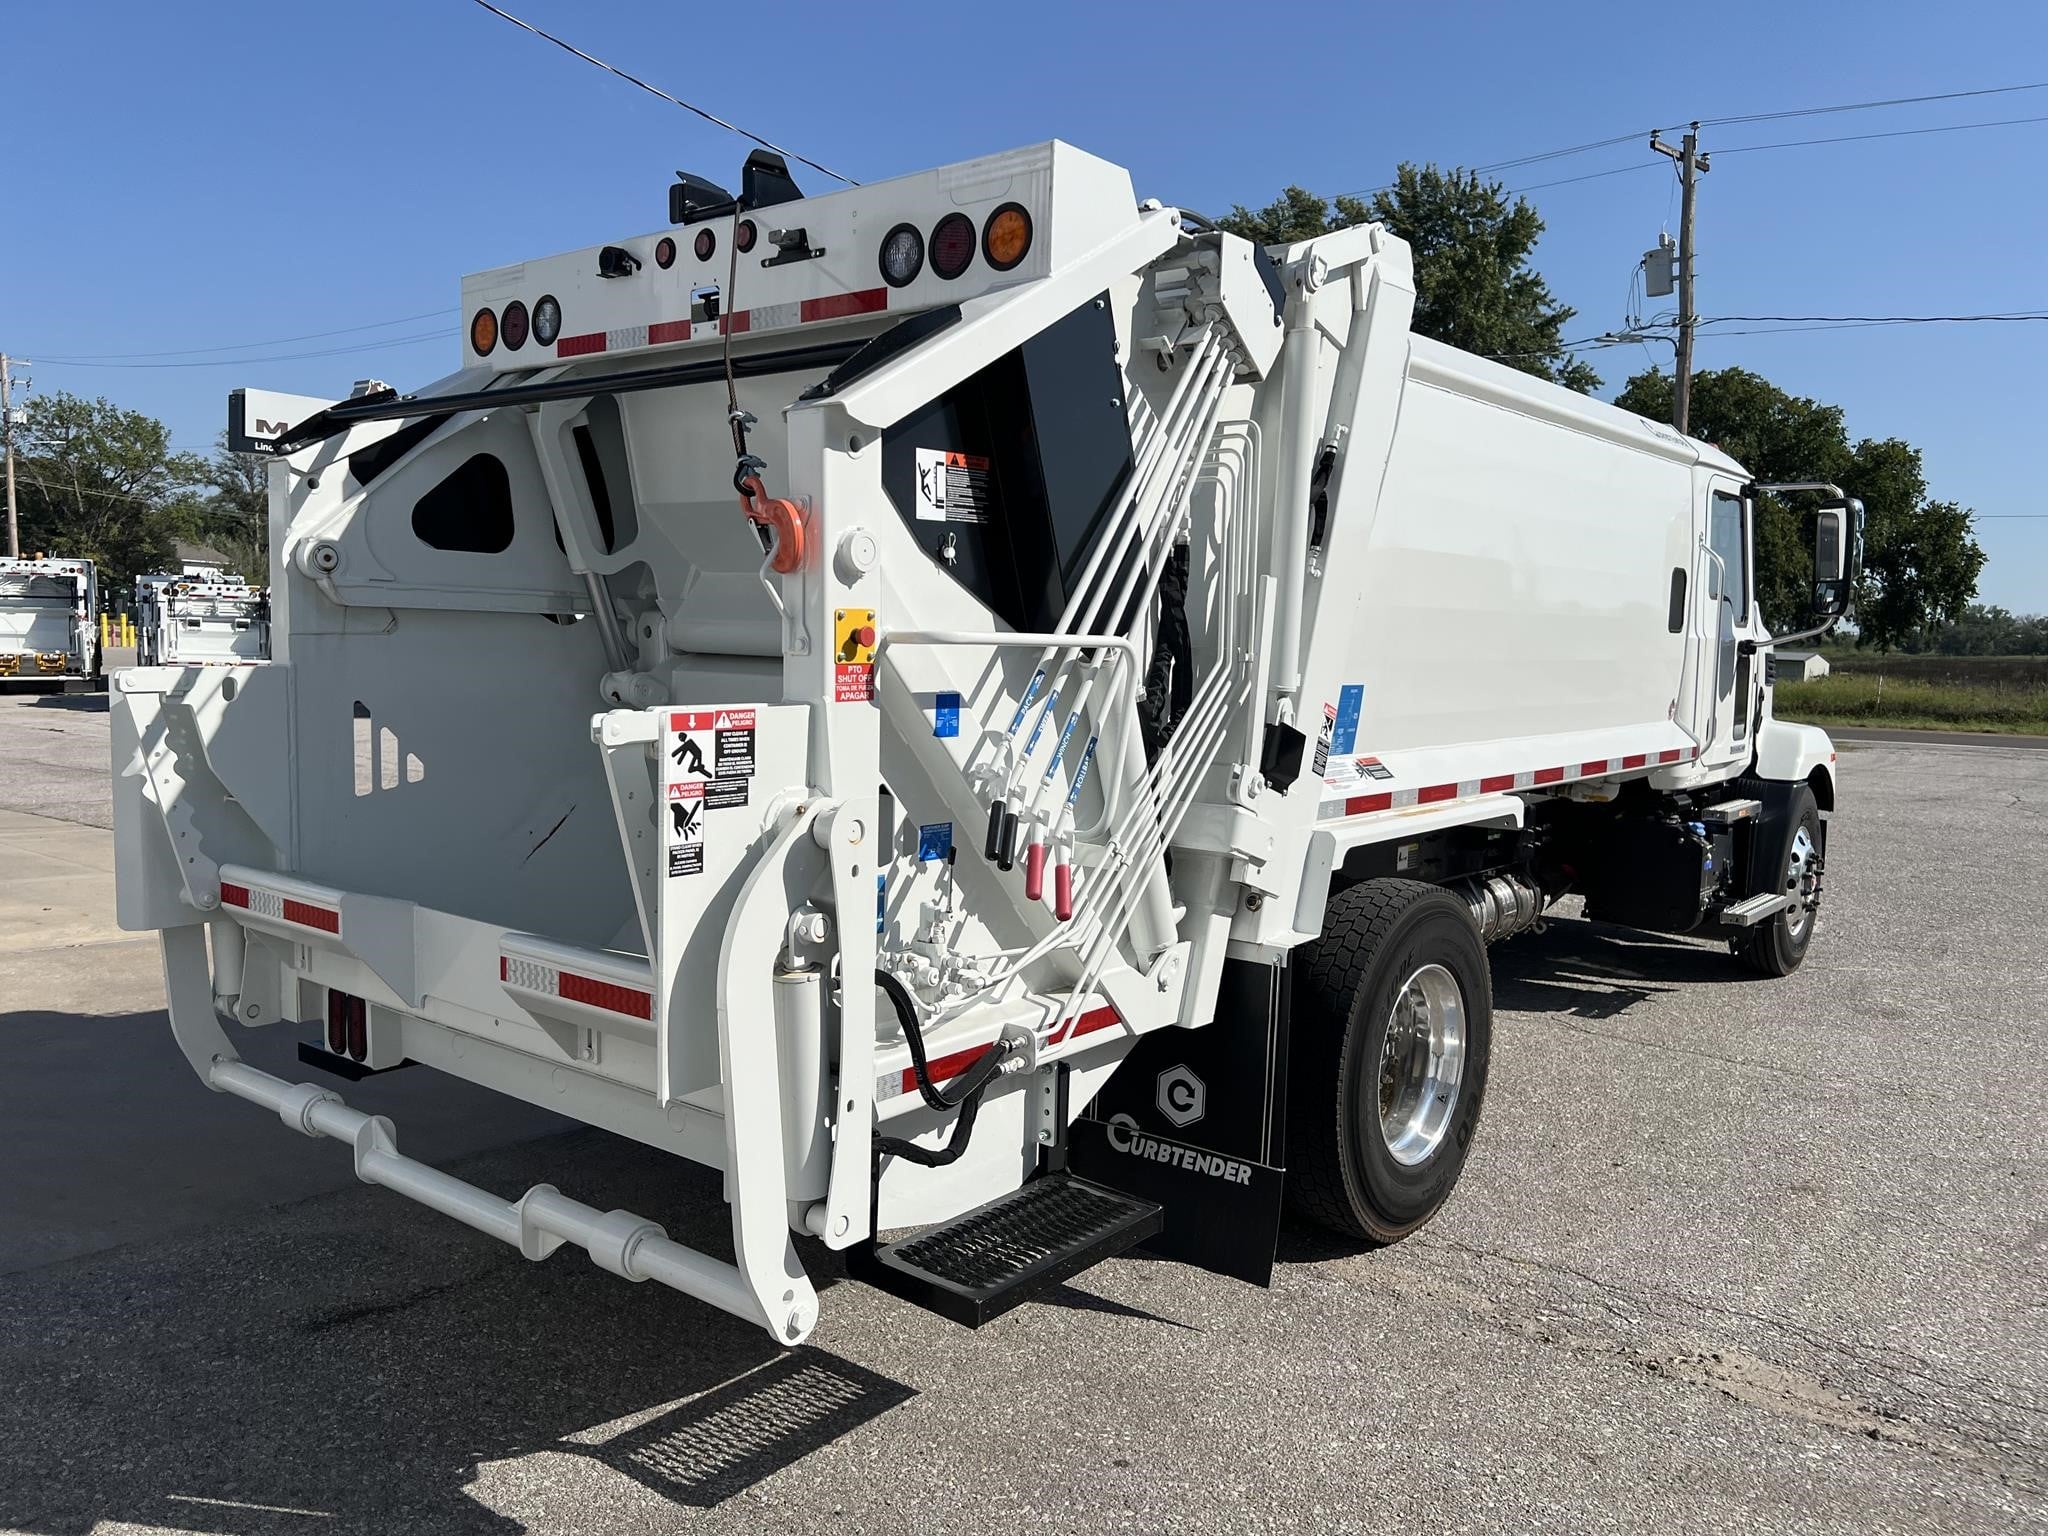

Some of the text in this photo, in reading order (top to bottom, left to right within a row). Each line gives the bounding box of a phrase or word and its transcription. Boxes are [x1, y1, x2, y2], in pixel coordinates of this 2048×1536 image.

[848, 665, 862, 673] PTO
[837, 674, 872, 683] SHUT OFF
[840, 692, 870, 700] APAGAR
[1020, 693, 1034, 714] PACK
[729, 712, 755, 720] DANGER
[1056, 732, 1071, 759] WINCH
[680, 784, 703, 792] DANGER
[680, 790, 702, 798] PELIGRO
[1107, 1113, 1252, 1185] CURBTENDER
